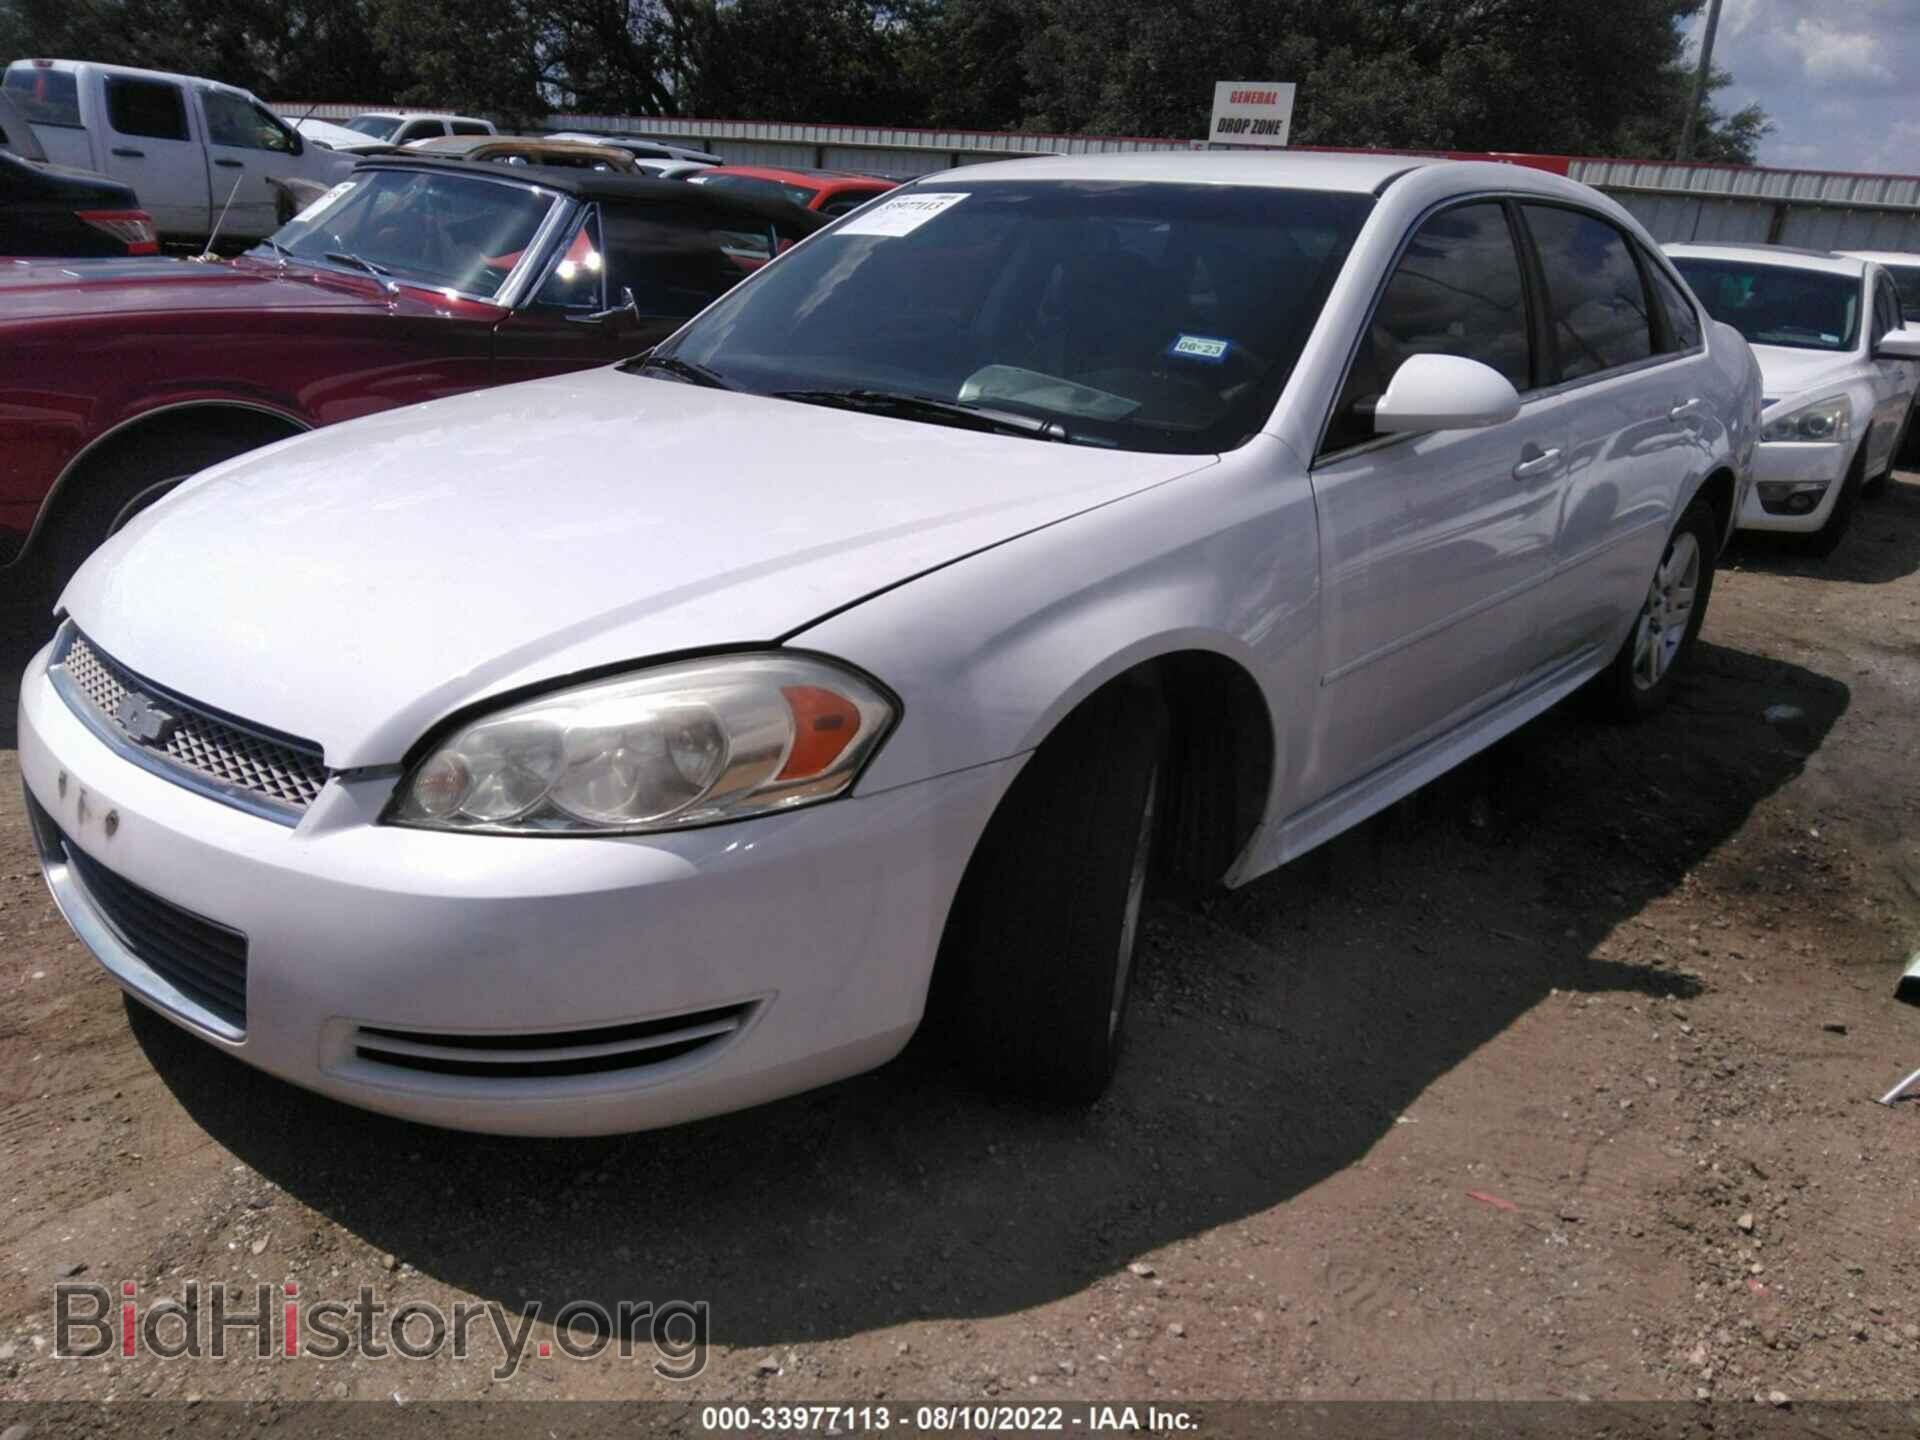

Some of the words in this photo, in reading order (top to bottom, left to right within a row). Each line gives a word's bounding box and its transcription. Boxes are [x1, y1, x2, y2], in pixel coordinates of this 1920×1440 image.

[1230, 90, 1278, 104] GENERAL
[1217, 117, 1250, 134] DROP
[1250, 119, 1283, 135] ZONE
